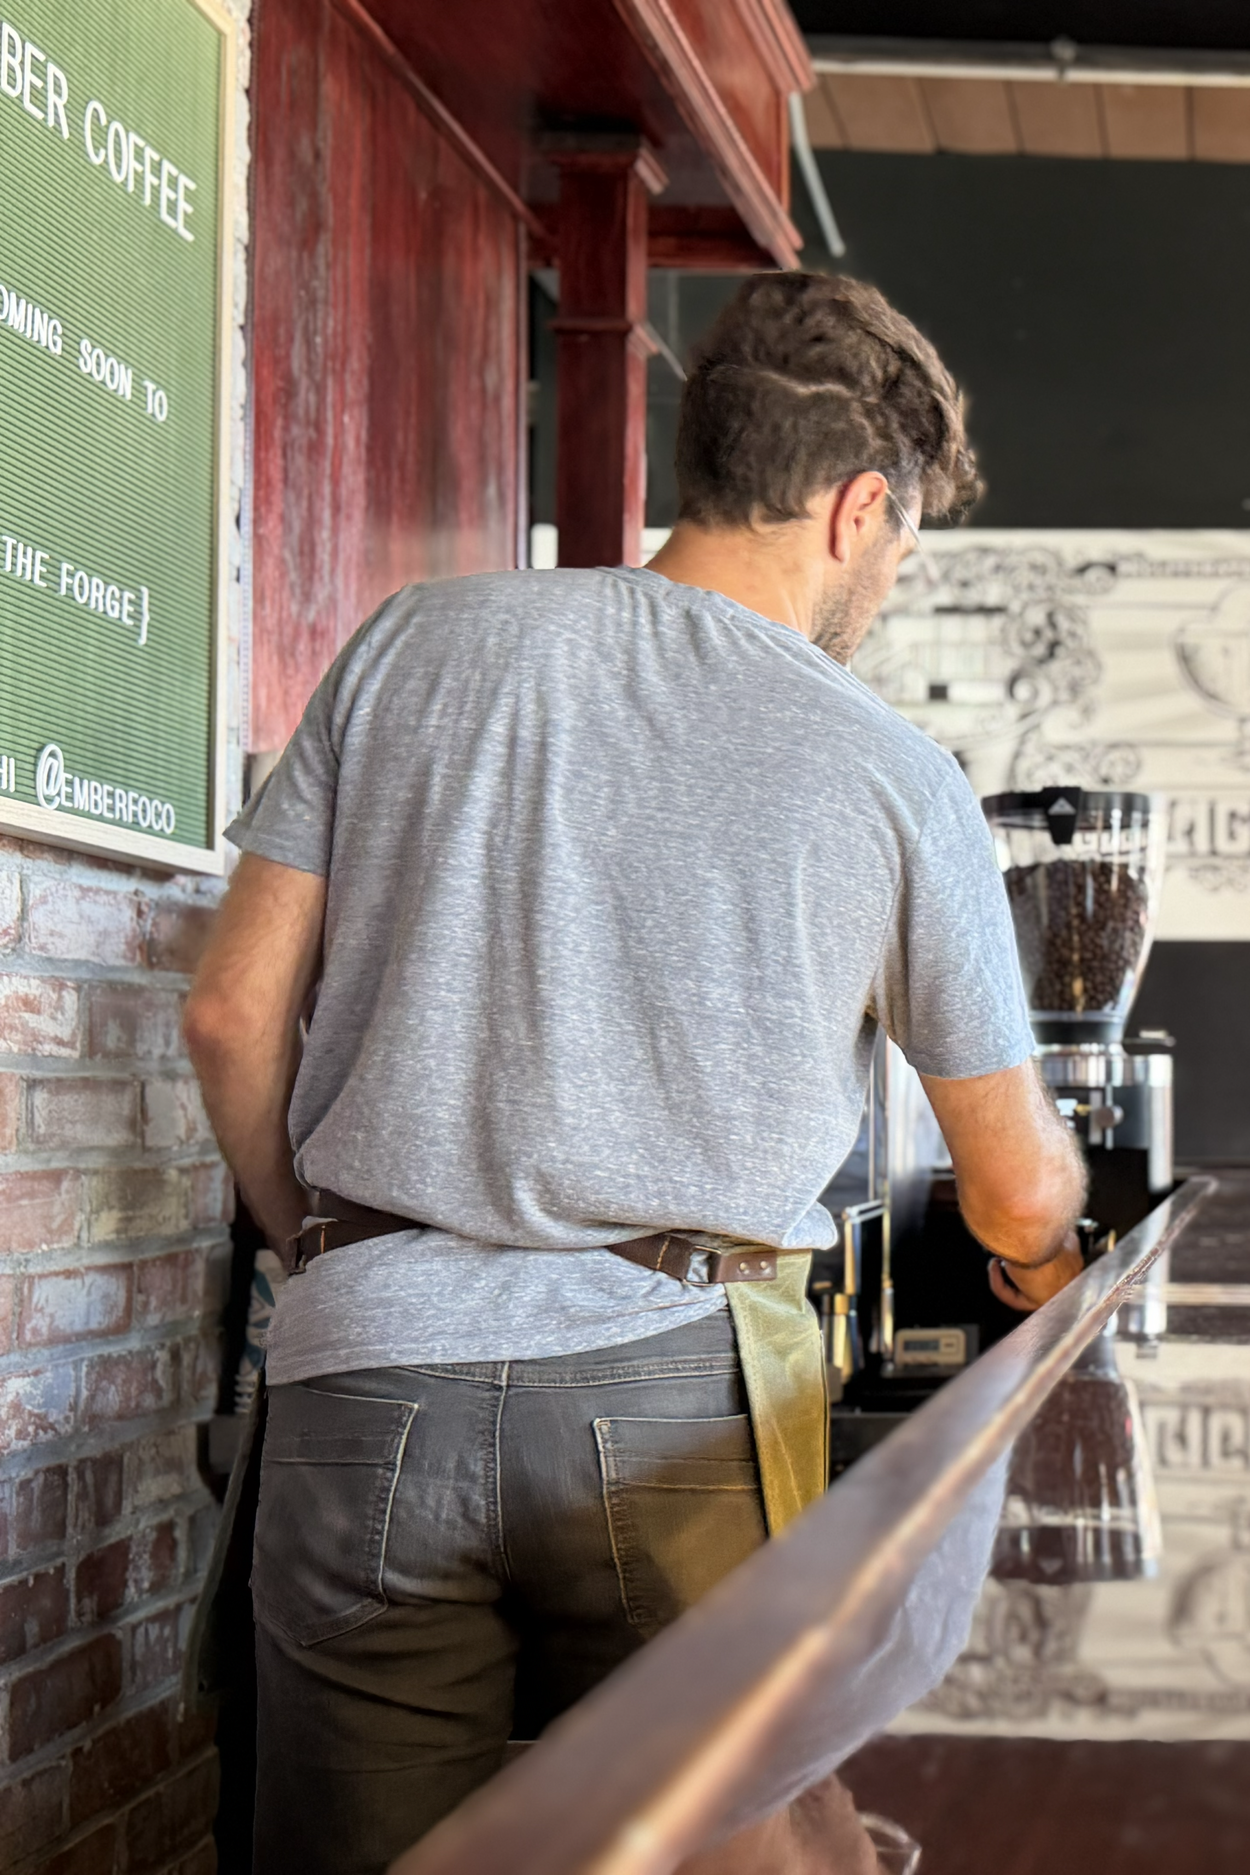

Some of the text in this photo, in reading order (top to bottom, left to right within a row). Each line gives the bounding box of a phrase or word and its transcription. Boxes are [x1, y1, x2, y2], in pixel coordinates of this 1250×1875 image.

[84, 100, 197, 242] COFFEE
[79, 338, 133, 401] SOON
[143, 379, 169, 422] TO
[2, 535, 50, 588] THE
[36, 743, 176, 835] @EMBERFOCO
